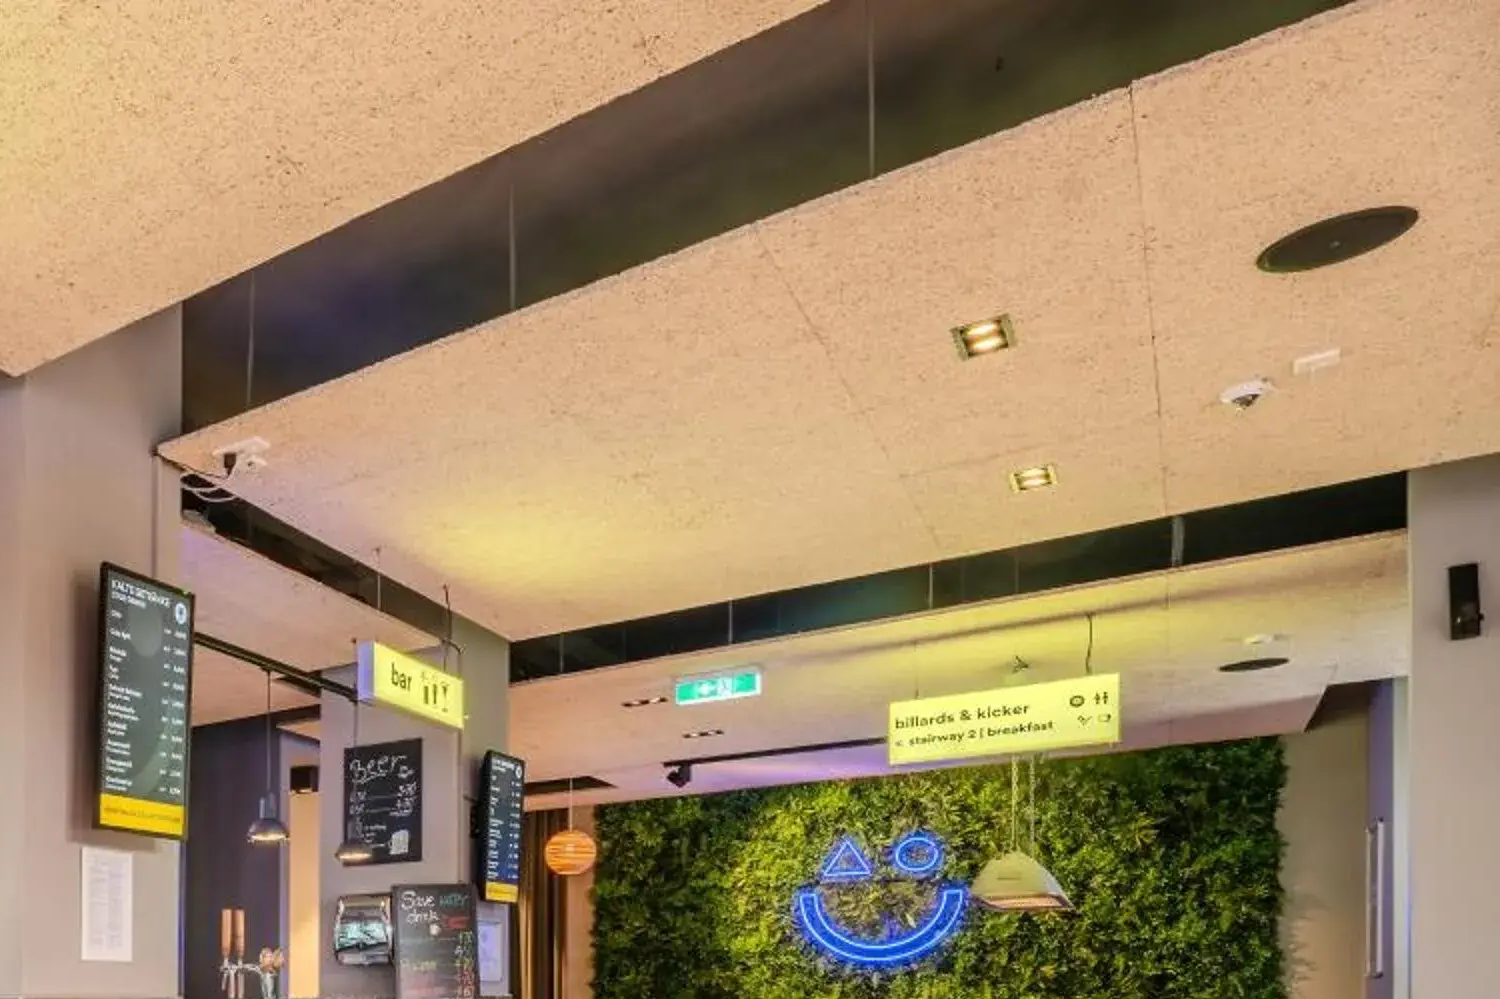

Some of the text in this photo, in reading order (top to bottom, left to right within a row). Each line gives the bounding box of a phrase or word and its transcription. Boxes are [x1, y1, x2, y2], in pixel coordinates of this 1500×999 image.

[390, 661, 413, 693] bar
[895, 704, 1030, 729] billards & kicker
[909, 733, 964, 746] stairway
[968, 730, 977, 739] 2
[987, 720, 1054, 737] breakfast
